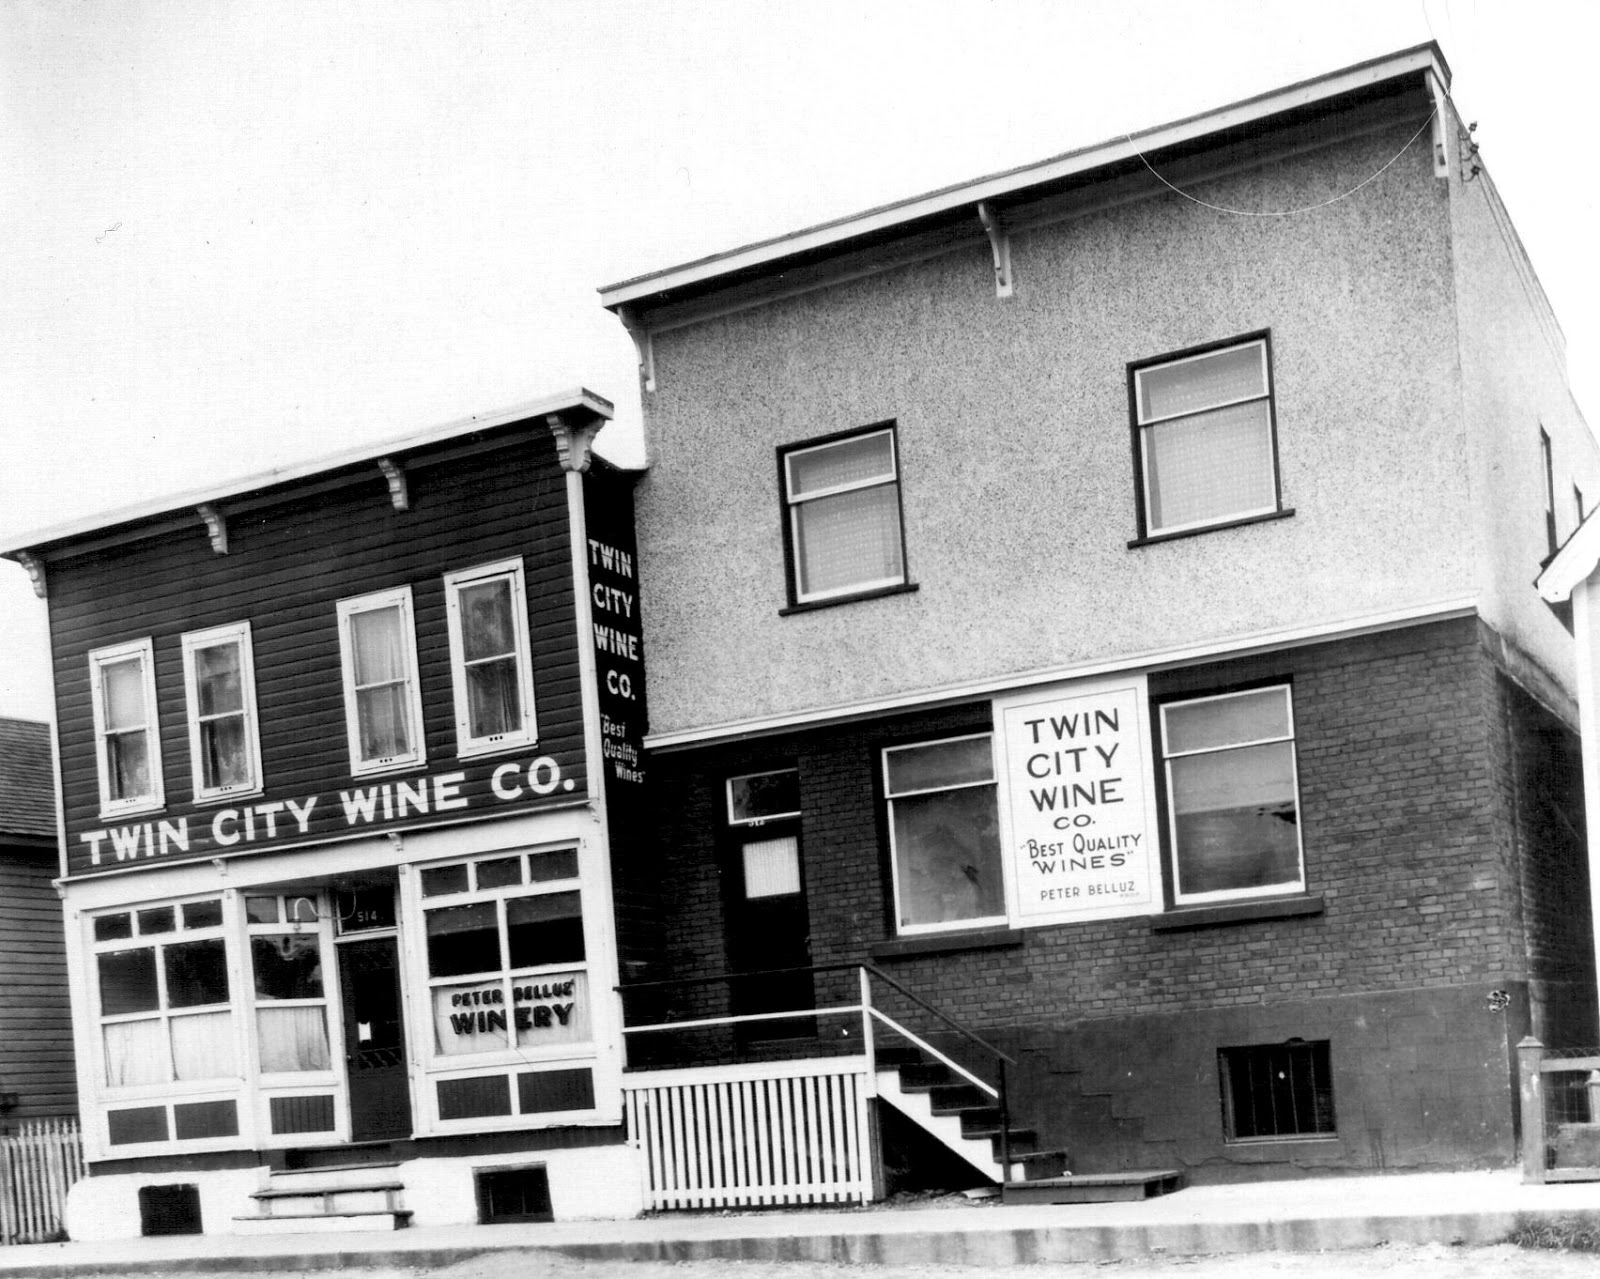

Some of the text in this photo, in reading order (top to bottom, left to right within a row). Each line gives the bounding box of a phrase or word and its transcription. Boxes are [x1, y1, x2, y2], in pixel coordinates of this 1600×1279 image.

[589, 538, 632, 578] TWIN
[593, 583, 633, 618] CITY
[594, 623, 639, 661] WINE
[606, 669, 636, 701] CO.
[1024, 708, 1120, 744] TWIN
[603, 738, 638, 768] Quality
[1026, 743, 1120, 779] CITY
[80, 756, 575, 865] TWIN CITY WINE CO.
[1029, 777, 1124, 812] WINE
[1053, 814, 1097, 831] CO.
[1072, 832, 1143, 856] QUALITY
[1040, 887, 1081, 901] PETER
[1088, 880, 1136, 897] BELLUZ
[357, 910, 378, 922] 514
[451, 988, 503, 1008] PETER
[450, 1003, 574, 1035] WINERY
